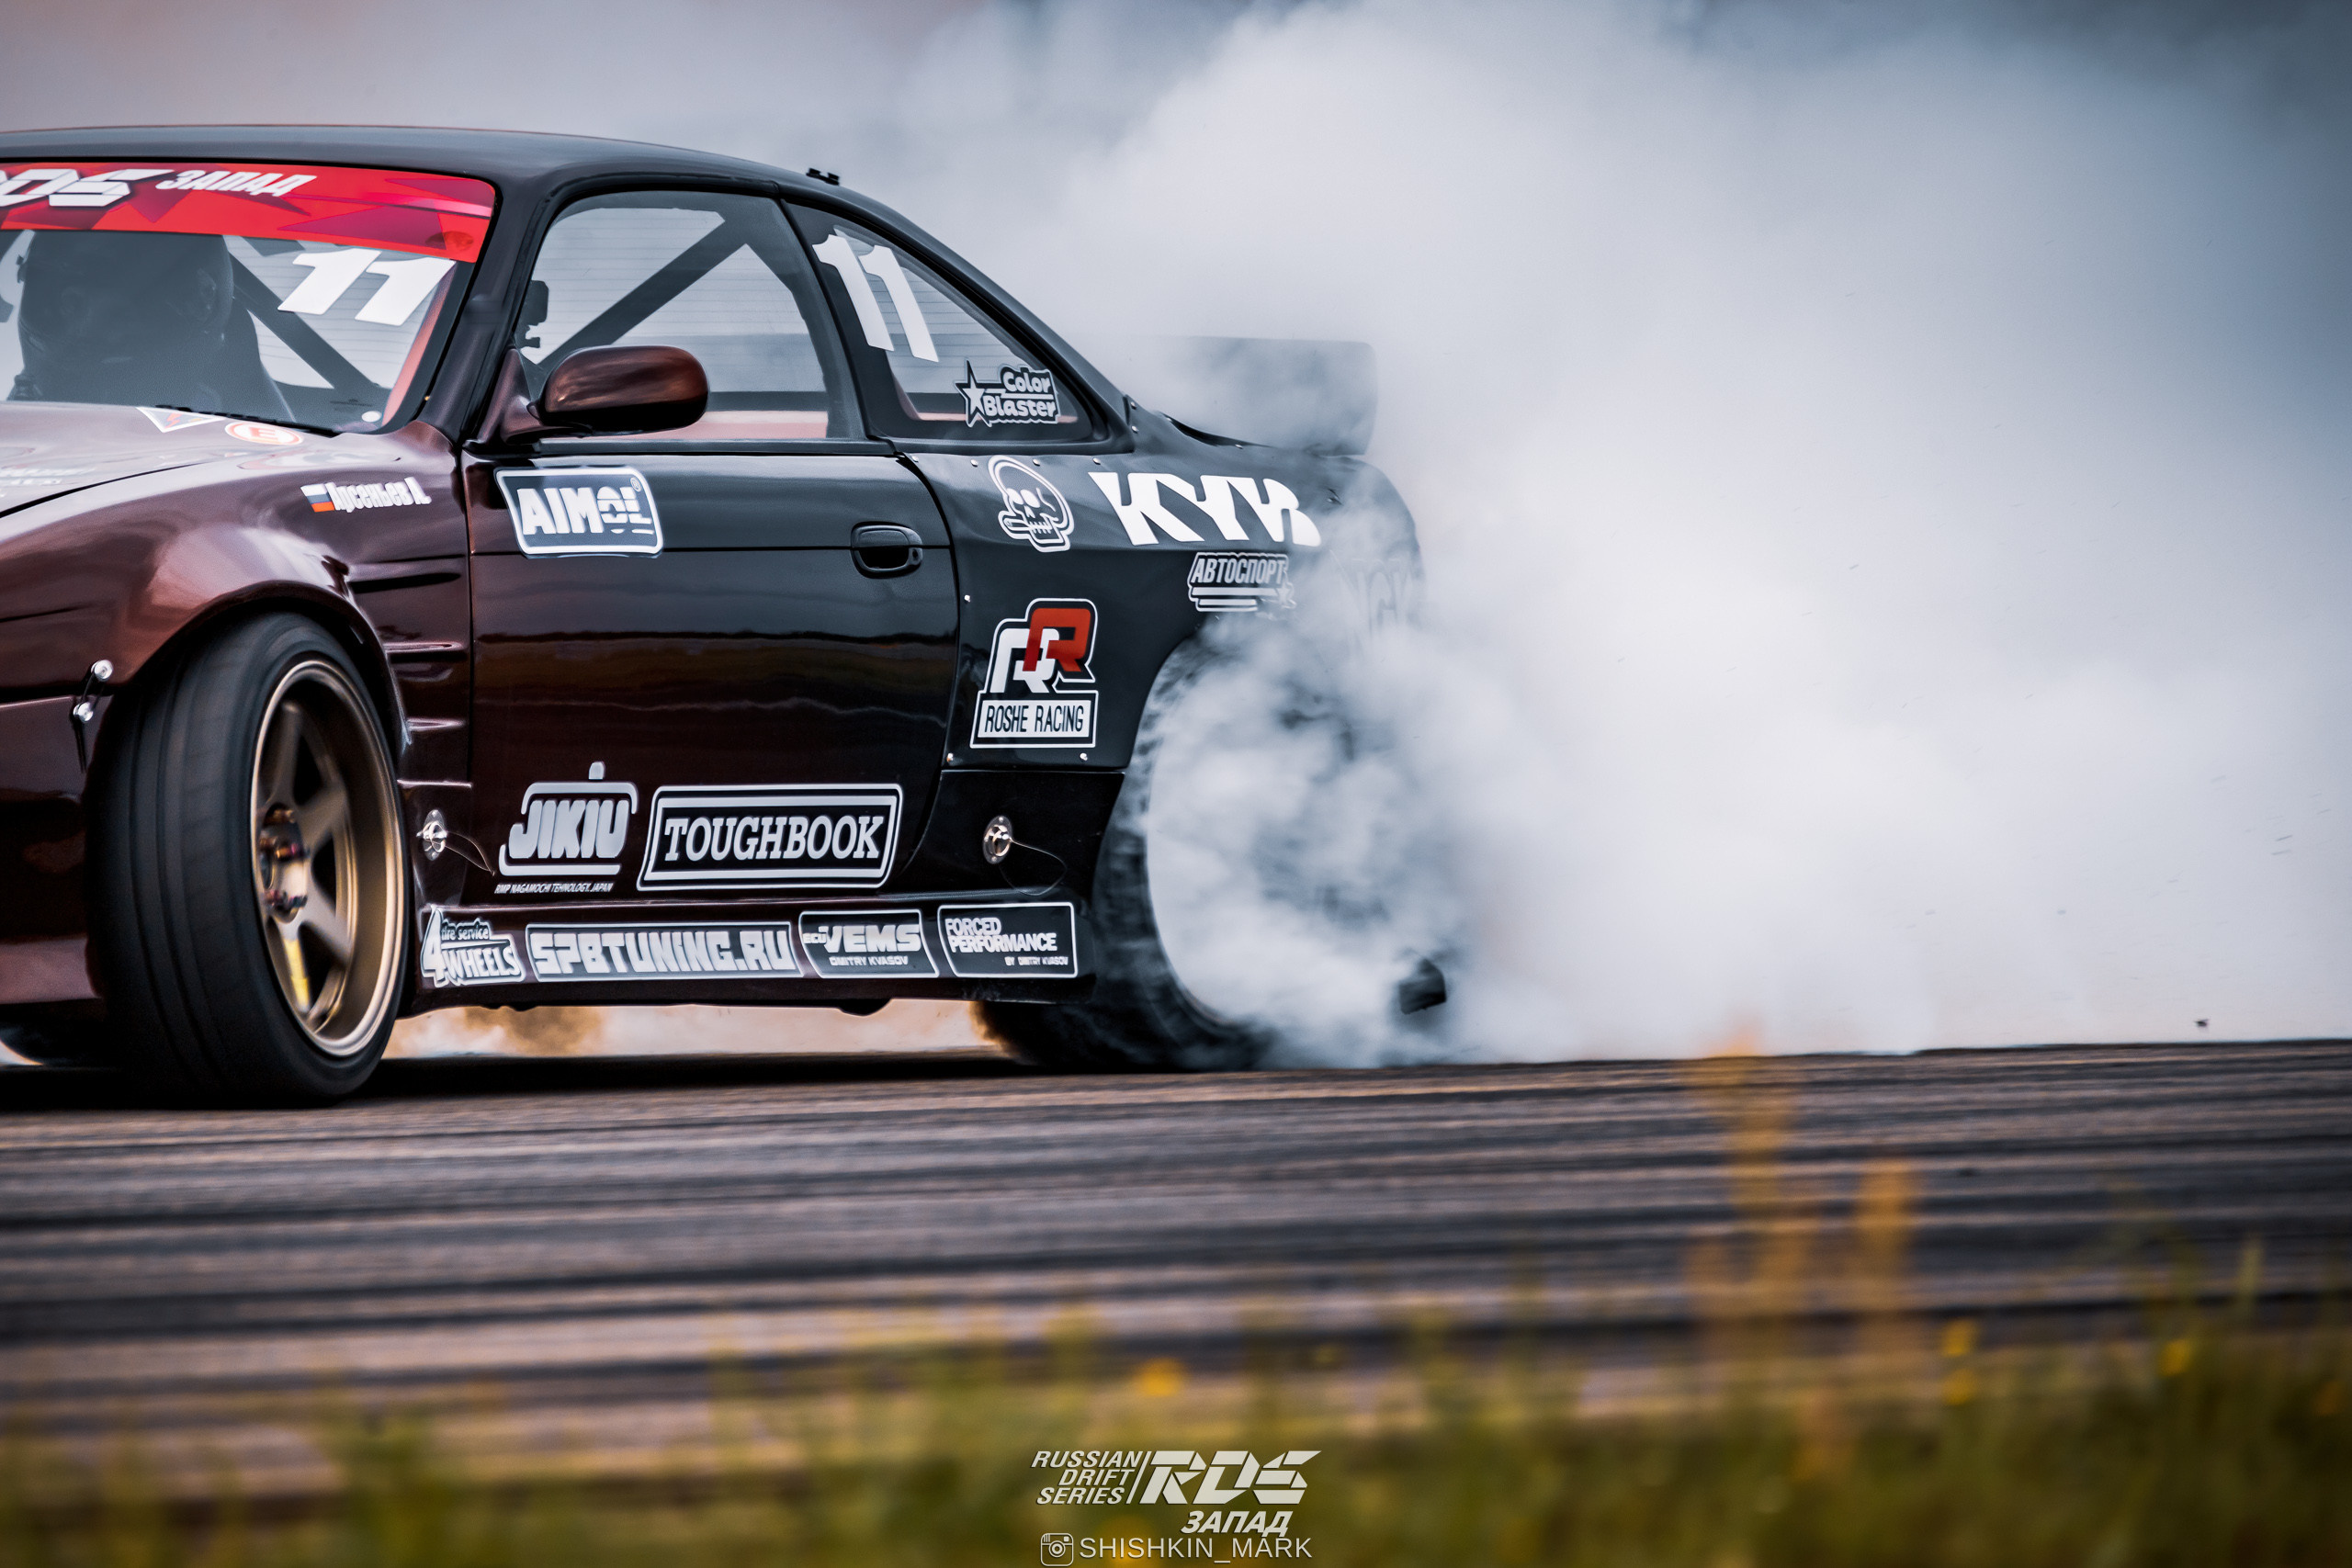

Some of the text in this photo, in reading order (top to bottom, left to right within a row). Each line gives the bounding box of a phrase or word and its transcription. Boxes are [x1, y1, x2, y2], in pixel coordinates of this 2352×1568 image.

[0, 169, 175, 207] DS
[155, 170, 317, 197] ЗАПАД
[277, 247, 456, 326] 11
[812, 234, 939, 363] 11
[1002, 371, 1051, 393] Color
[981, 394, 1057, 418] Blaster
[516, 487, 654, 535] AIMOL
[1089, 471, 1321, 547] KYB
[1191, 558, 1285, 583] АВТОСПОРТ
[984, 705, 1084, 732] ROSHE RACING
[663, 816, 885, 862] TOUGHBOOK
[441, 924, 490, 941] tire service
[819, 924, 922, 953] VEMS
[944, 918, 1002, 936] FORCED
[530, 931, 795, 975] SPBTUNING.RU
[949, 932, 1057, 953] PERFORMANCE
[867, 955, 909, 965] KVASOV
